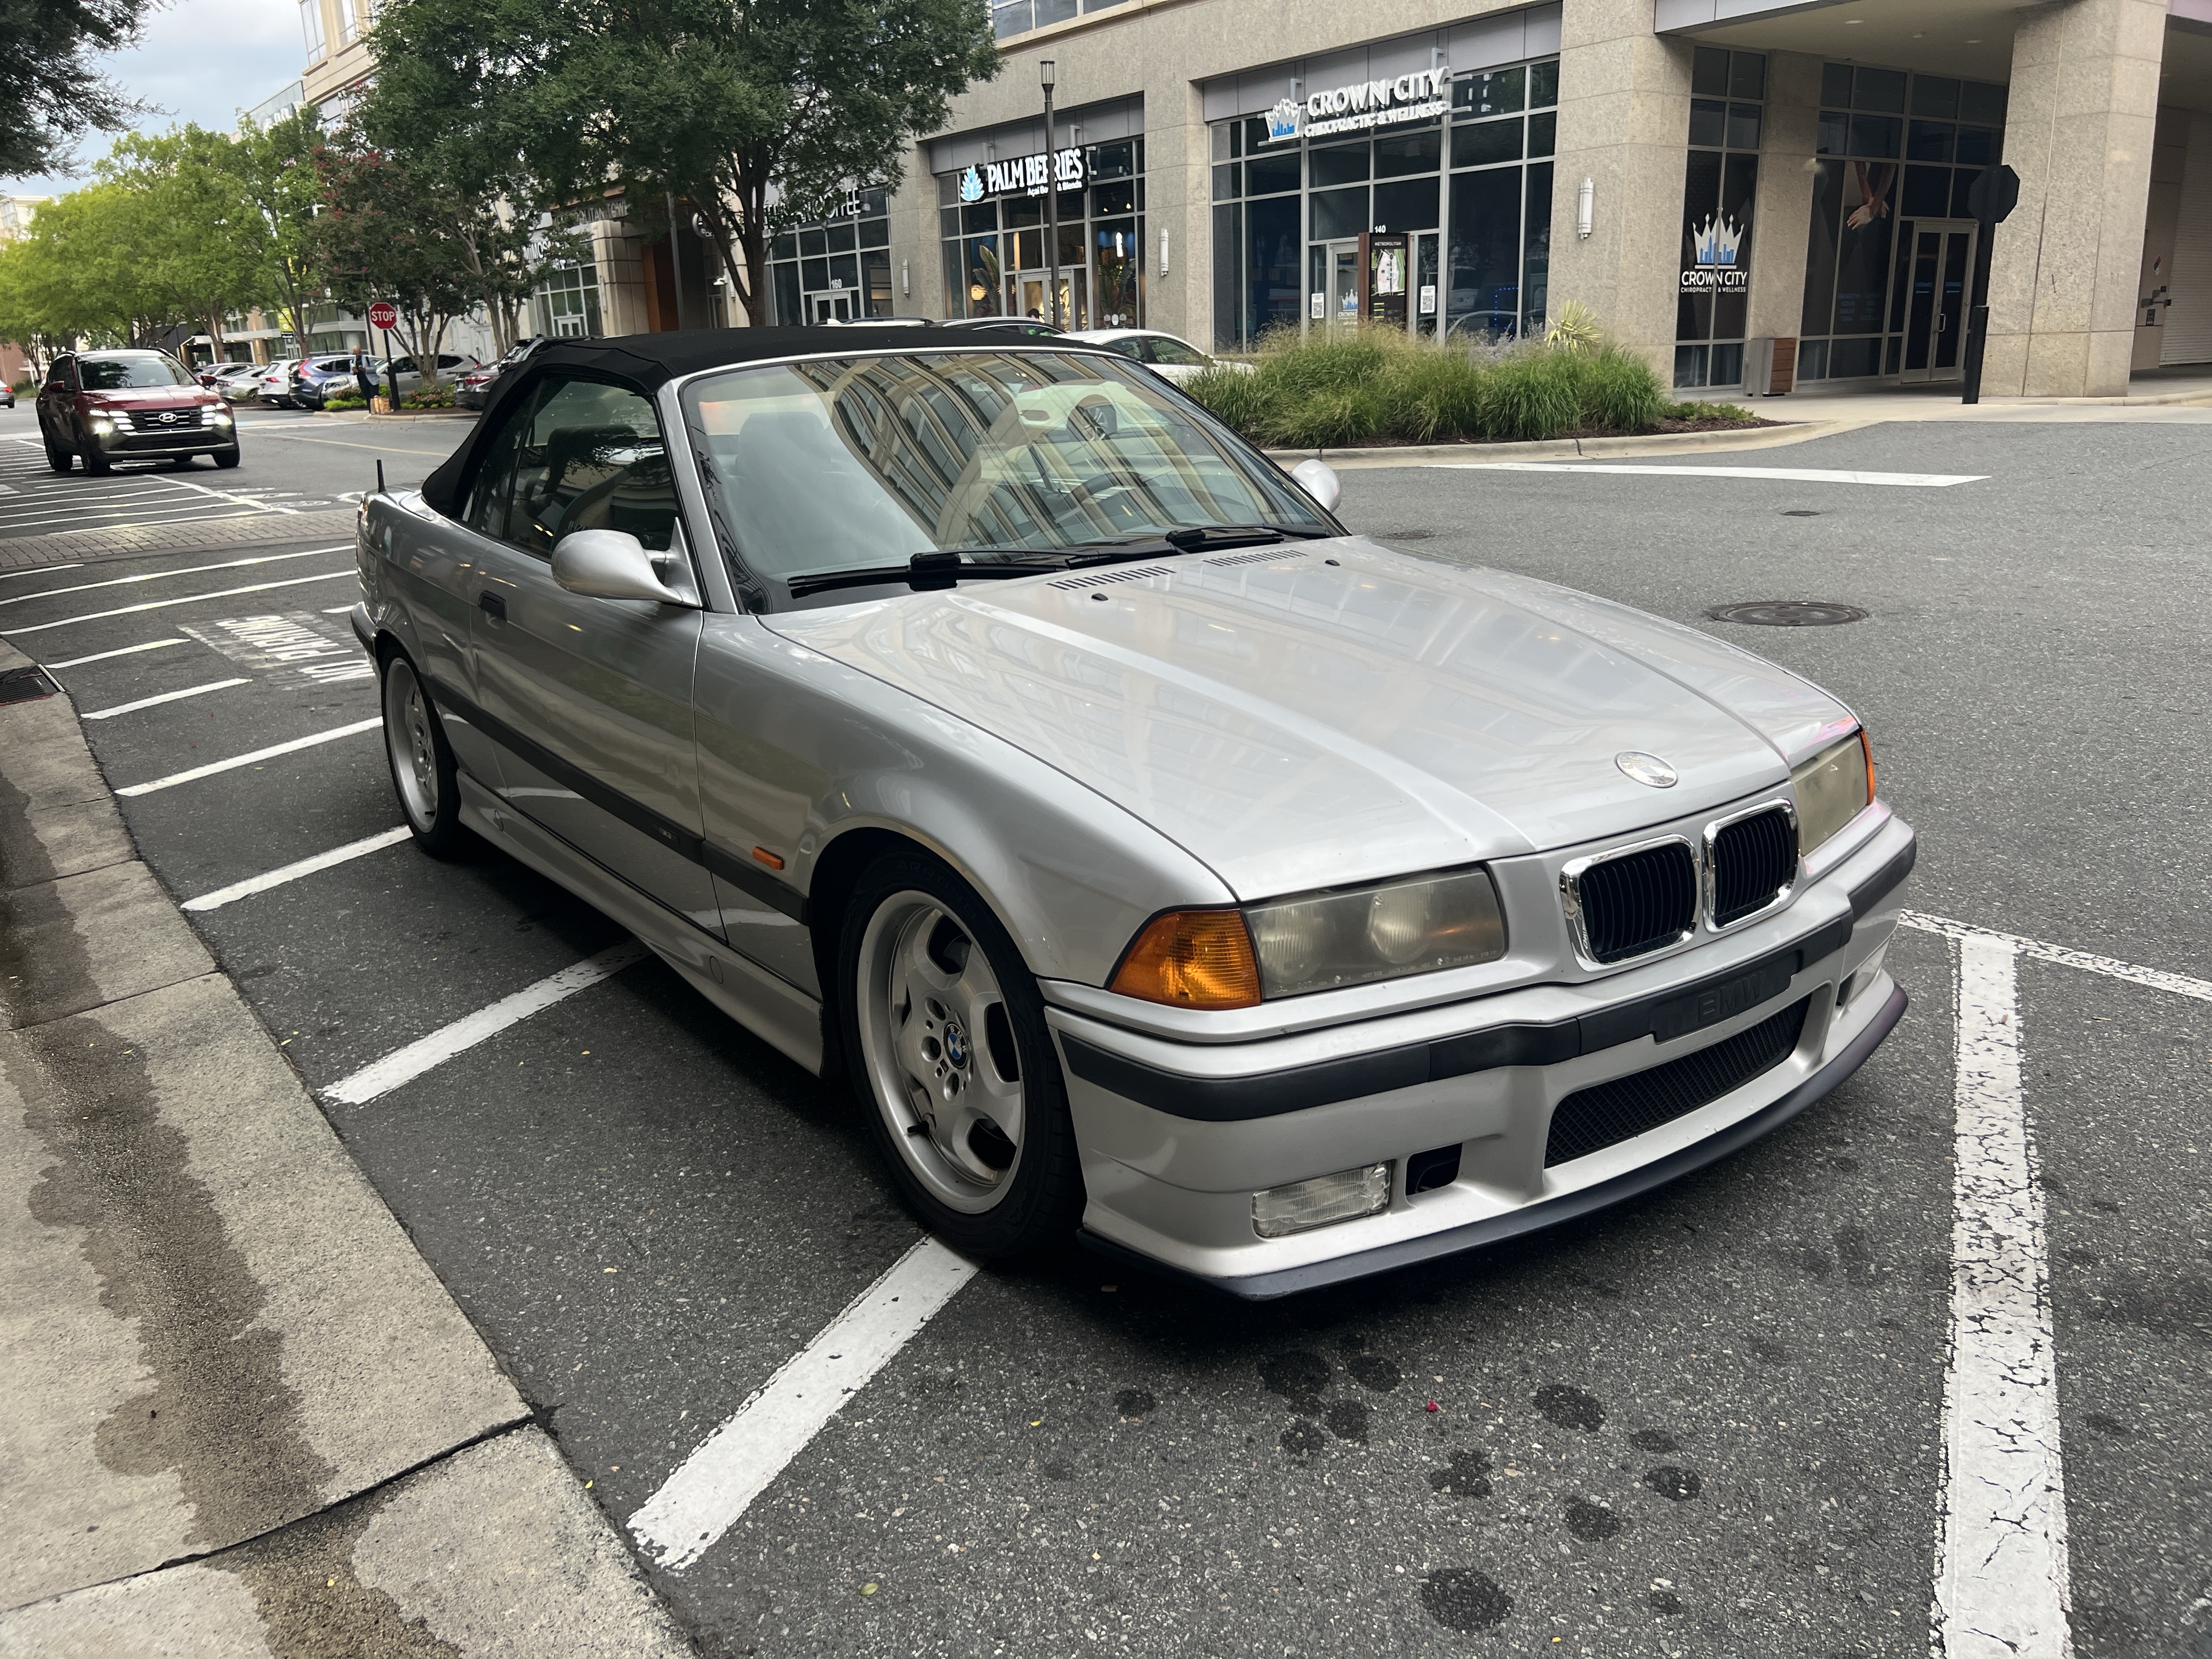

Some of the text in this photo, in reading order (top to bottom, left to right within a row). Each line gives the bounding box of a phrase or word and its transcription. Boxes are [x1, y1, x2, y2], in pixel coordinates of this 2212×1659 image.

[1307, 66, 1448, 116] CROWN CITY
[1305, 101, 1447, 137] CHIROPRACTIC & WELLNESS
[988, 159, 1025, 193] PALM
[1374, 224, 1386, 233] 140
[831, 279, 843, 289] 160
[1681, 271, 1748, 285] CROWN CITY
[371, 311, 395, 321] STOP
[216, 616, 354, 661] PARKING
